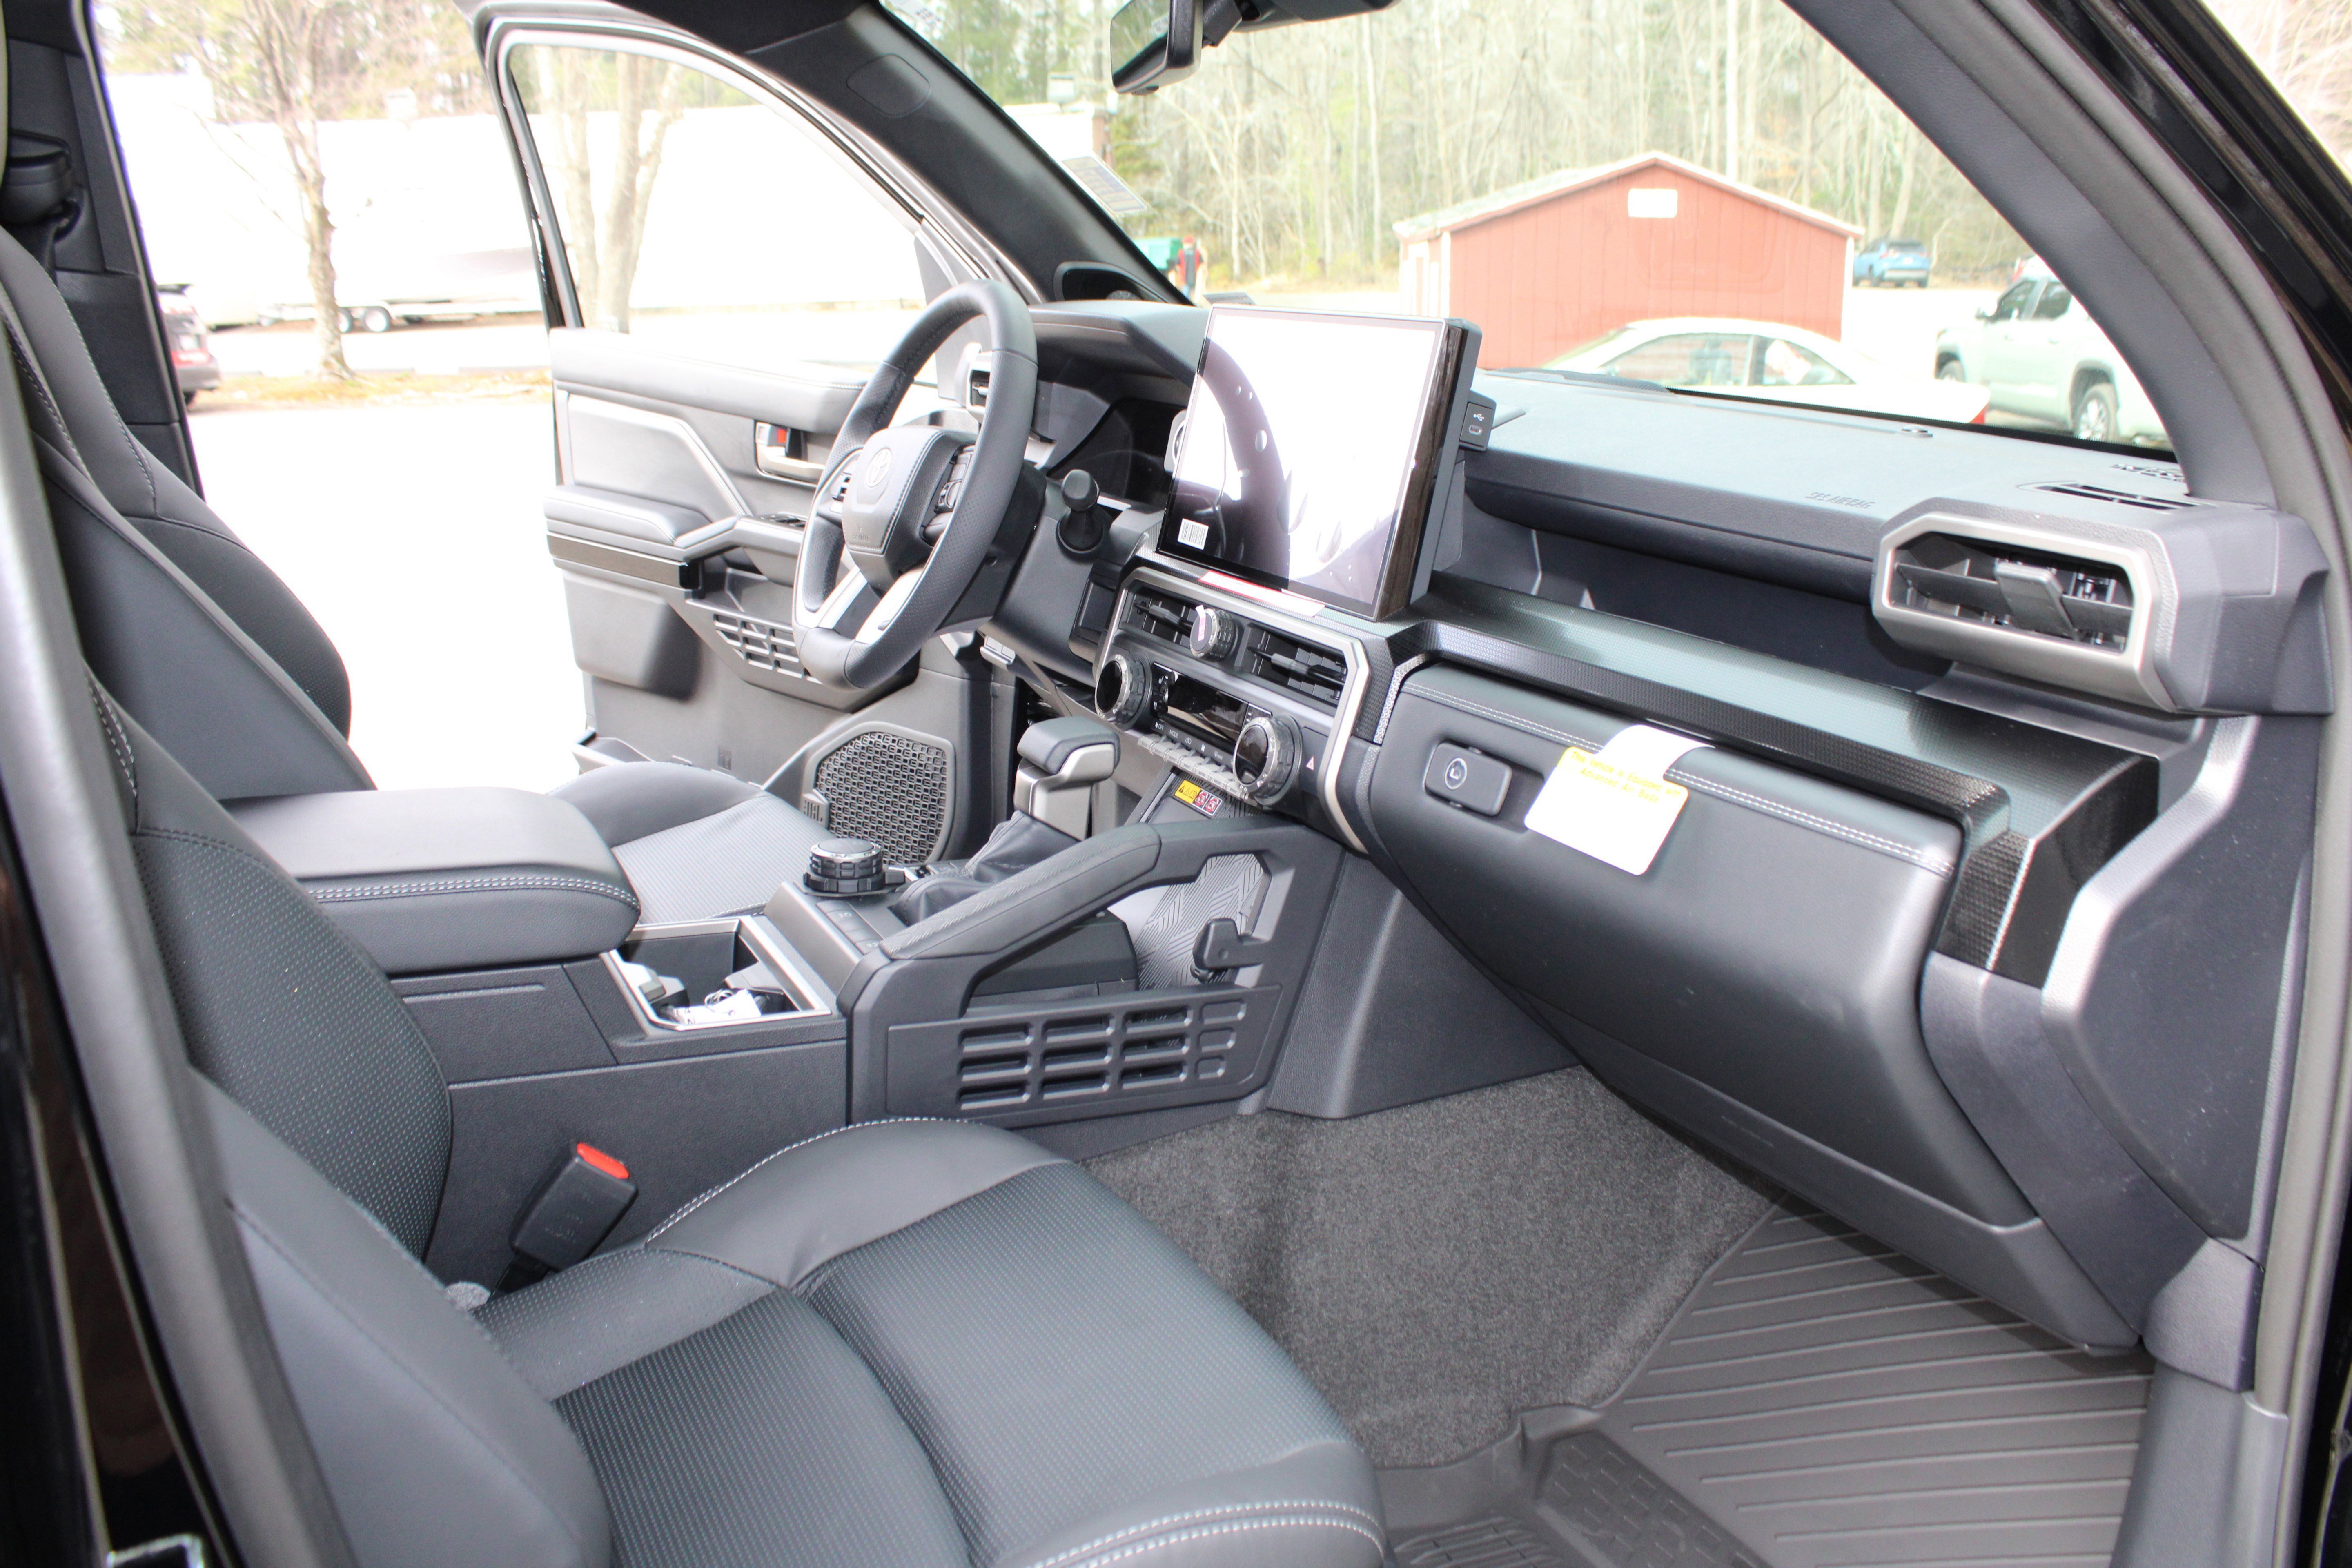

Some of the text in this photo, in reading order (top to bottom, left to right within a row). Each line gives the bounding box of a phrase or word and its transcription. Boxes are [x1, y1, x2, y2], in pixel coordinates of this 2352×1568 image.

[1826, 495, 1876, 509] AIRBAG
[1169, 729, 1178, 739] MODE
[1571, 751, 1586, 763] This
[1627, 772, 1662, 792] Equipped
[1581, 768, 1617, 788] Advanced
[1638, 788, 1659, 803] Bags
